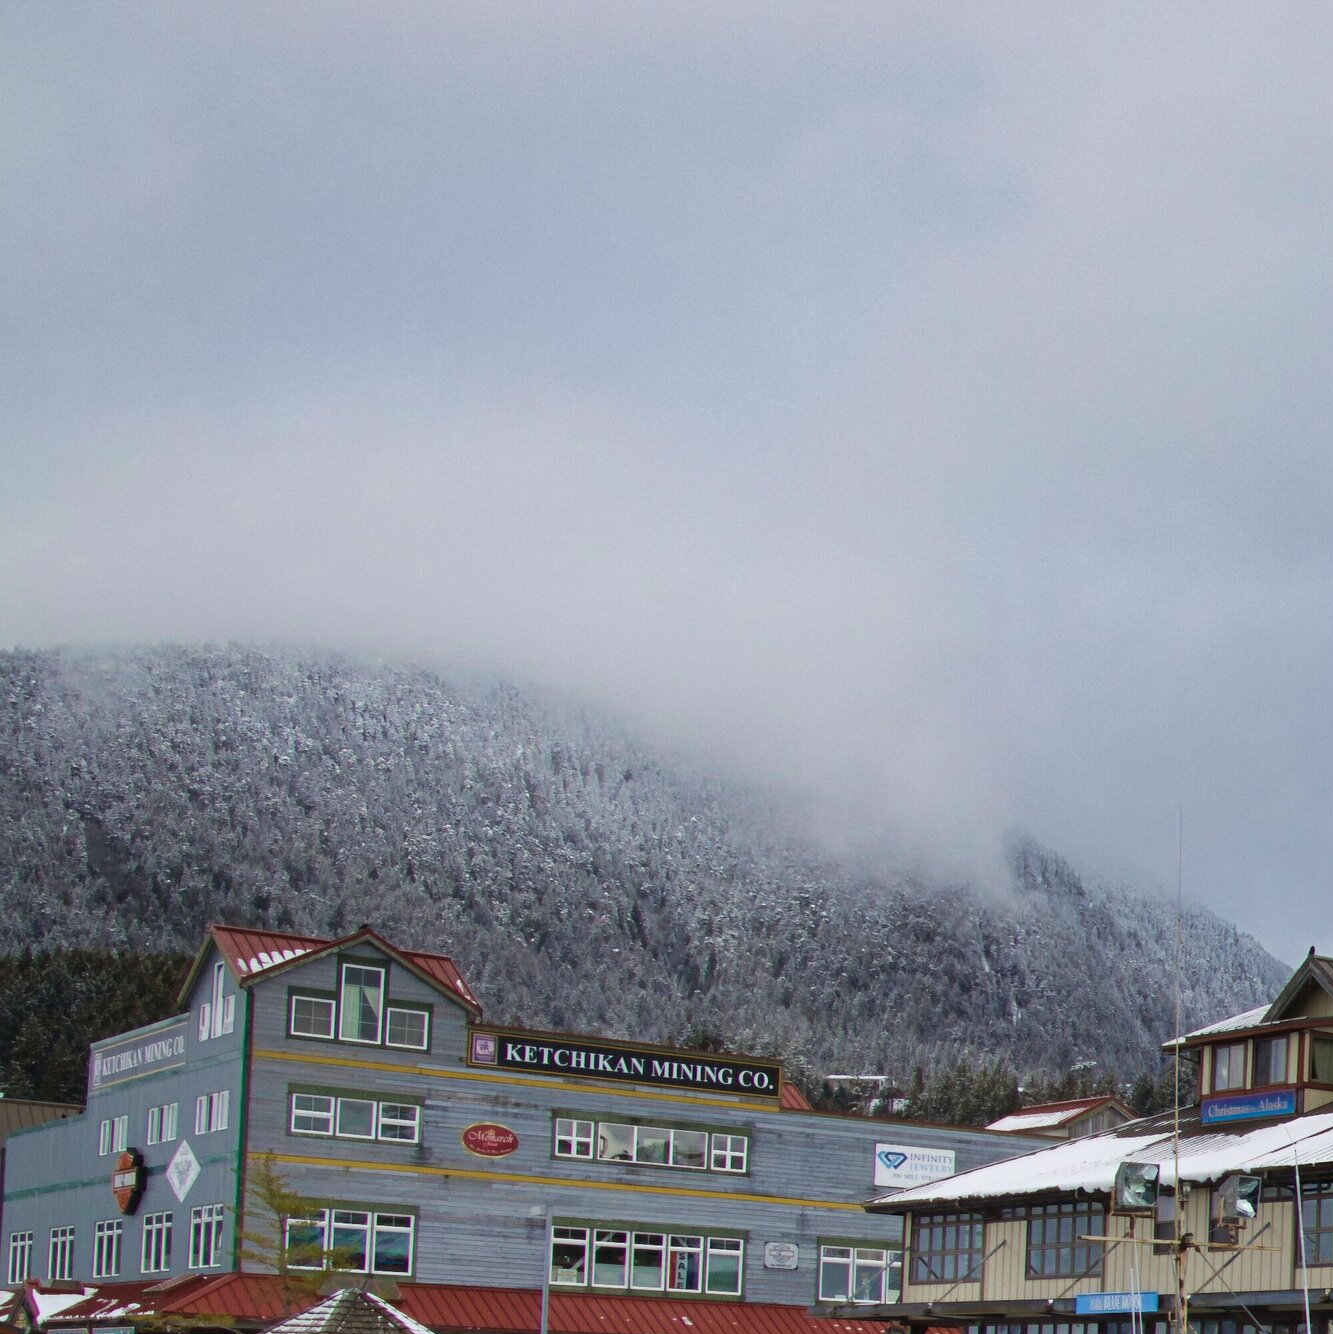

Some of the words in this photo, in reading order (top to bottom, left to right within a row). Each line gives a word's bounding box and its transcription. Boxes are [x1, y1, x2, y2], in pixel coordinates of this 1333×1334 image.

[102, 1048, 142, 1076] KETCHIKAN
[144, 1038, 172, 1065] MINING
[505, 1043, 645, 1075] KETCHIKAN
[651, 1059, 733, 1085] MINING
[738, 1070, 775, 1090] CO.
[1208, 1104, 1250, 1118] Christmas
[1259, 1097, 1288, 1112] Alaska
[468, 1130, 513, 1143] Monarch
[910, 1153, 954, 1164] INFINITY
[910, 1163, 954, 1173] JEWELRY
